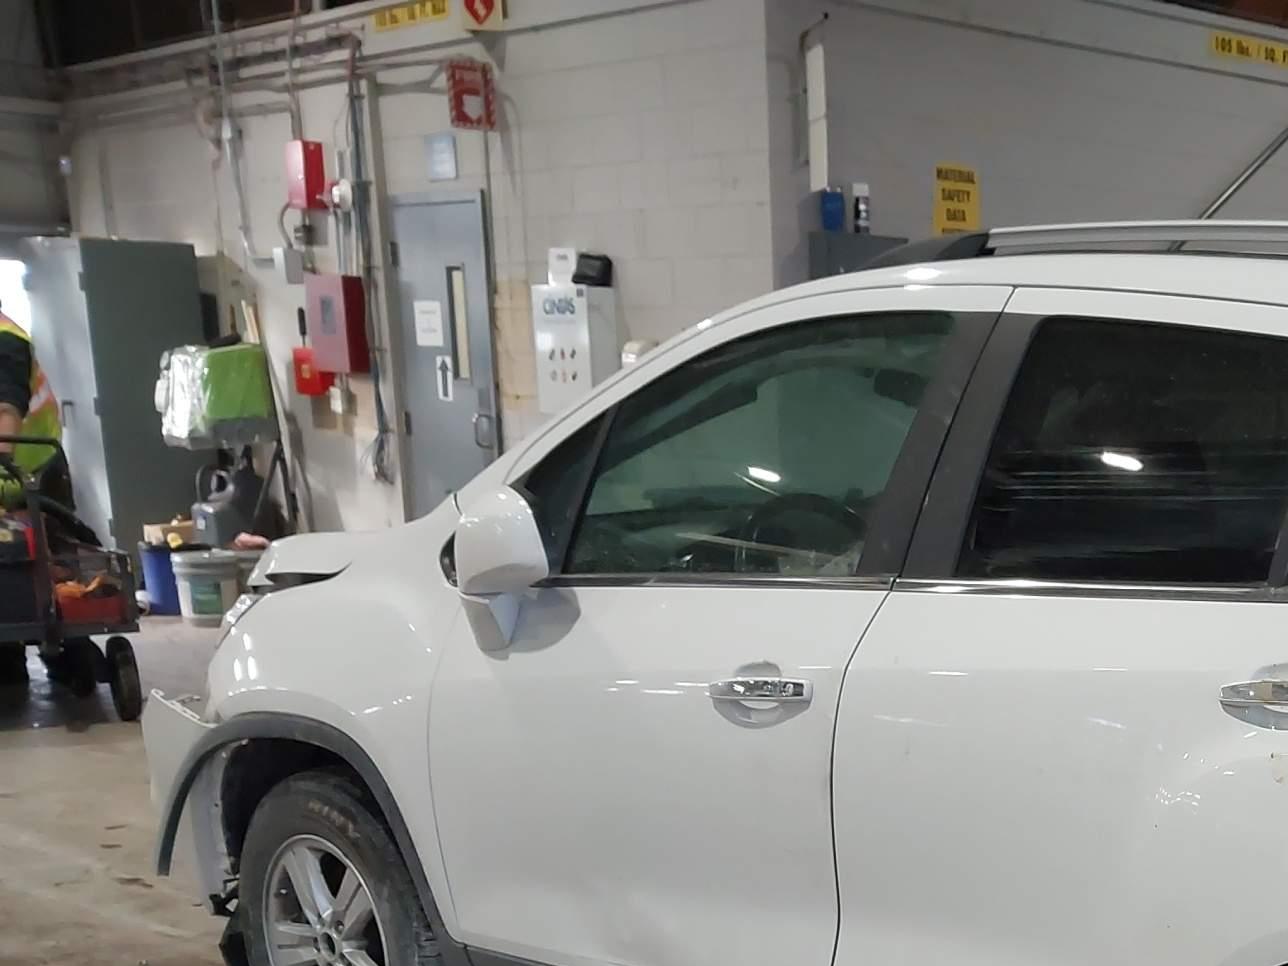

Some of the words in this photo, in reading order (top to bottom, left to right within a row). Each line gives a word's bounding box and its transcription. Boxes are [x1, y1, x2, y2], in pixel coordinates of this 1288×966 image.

[1215, 35, 1233, 54] 105
[936, 166, 976, 184] MATERIAL
[942, 187, 971, 203] SAFETY
[946, 207, 967, 222] DATA
